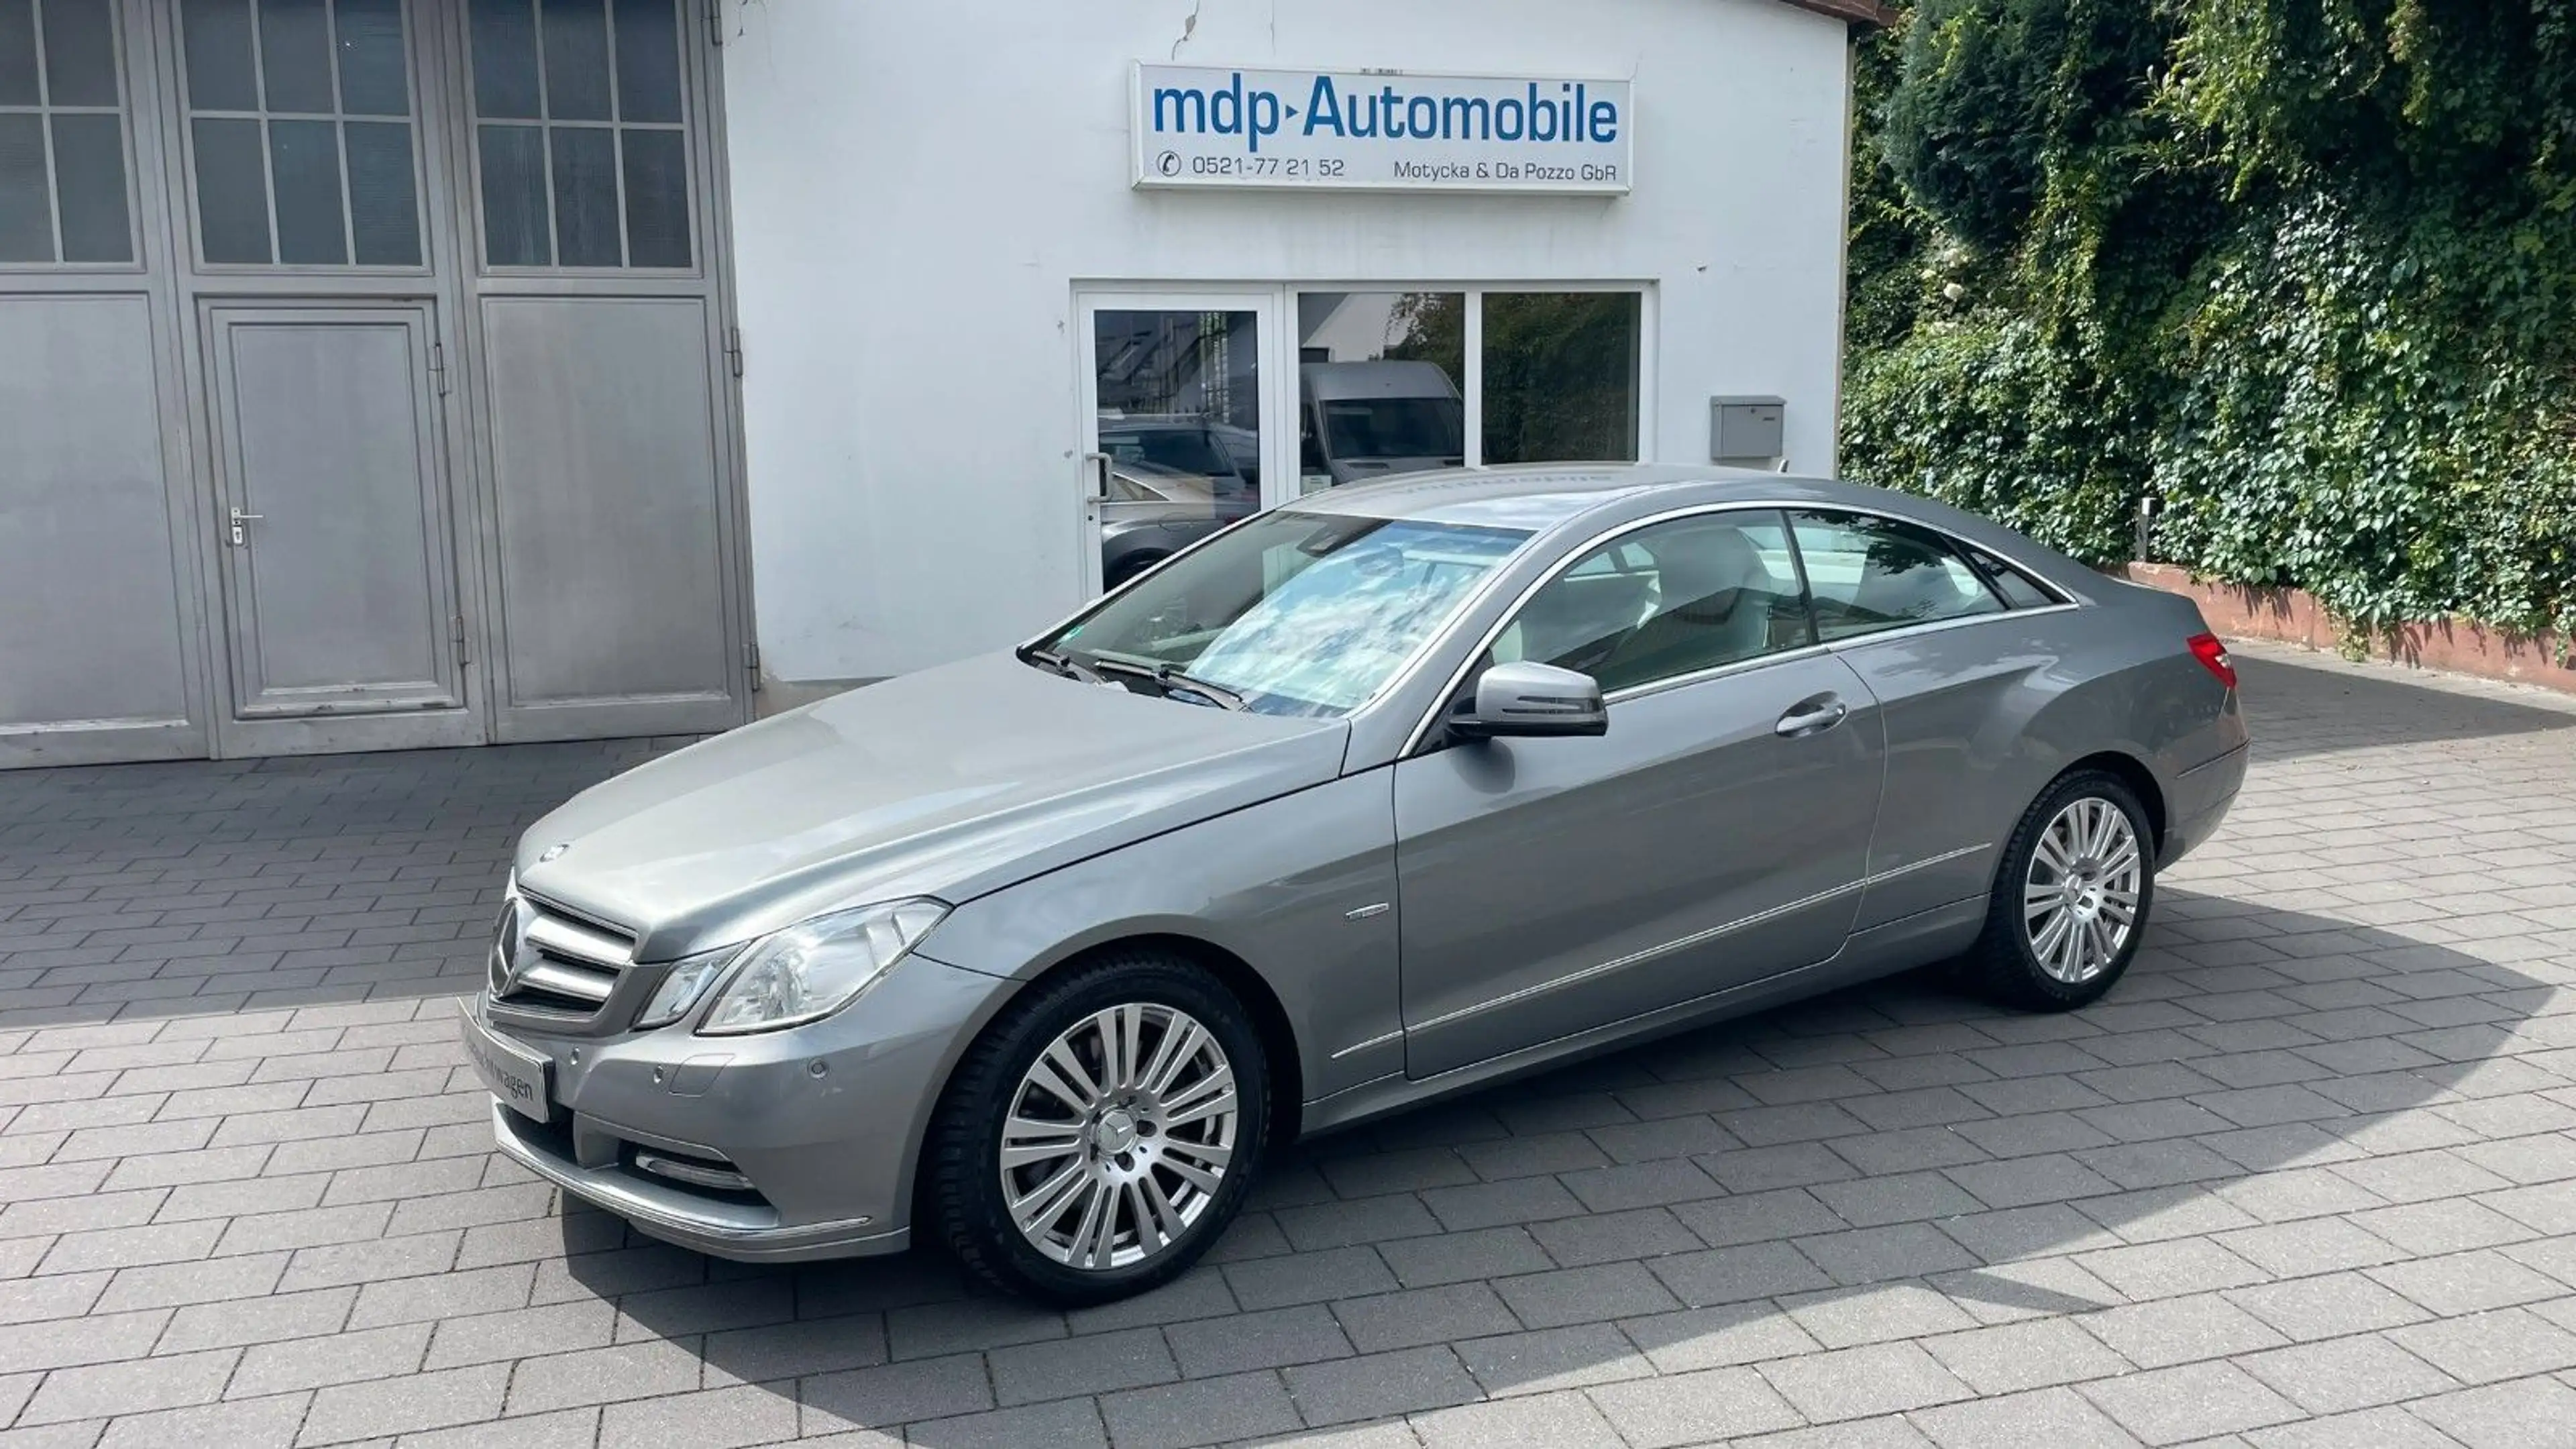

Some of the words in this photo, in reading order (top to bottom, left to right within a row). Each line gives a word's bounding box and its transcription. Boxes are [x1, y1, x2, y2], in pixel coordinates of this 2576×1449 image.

[1154, 72, 1279, 152] mdp
[1303, 75, 1617, 142] Automobile
[1193, 156, 1279, 175] 0521-77
[1286, 158, 1309, 176] 21
[1319, 160, 1344, 176] 52
[1394, 160, 1469, 181] Motycka
[1477, 162, 1490, 178] &
[1496, 162, 1519, 178] Da
[1525, 163, 1575, 180] Pozzo
[1581, 164, 1617, 181] GbR
